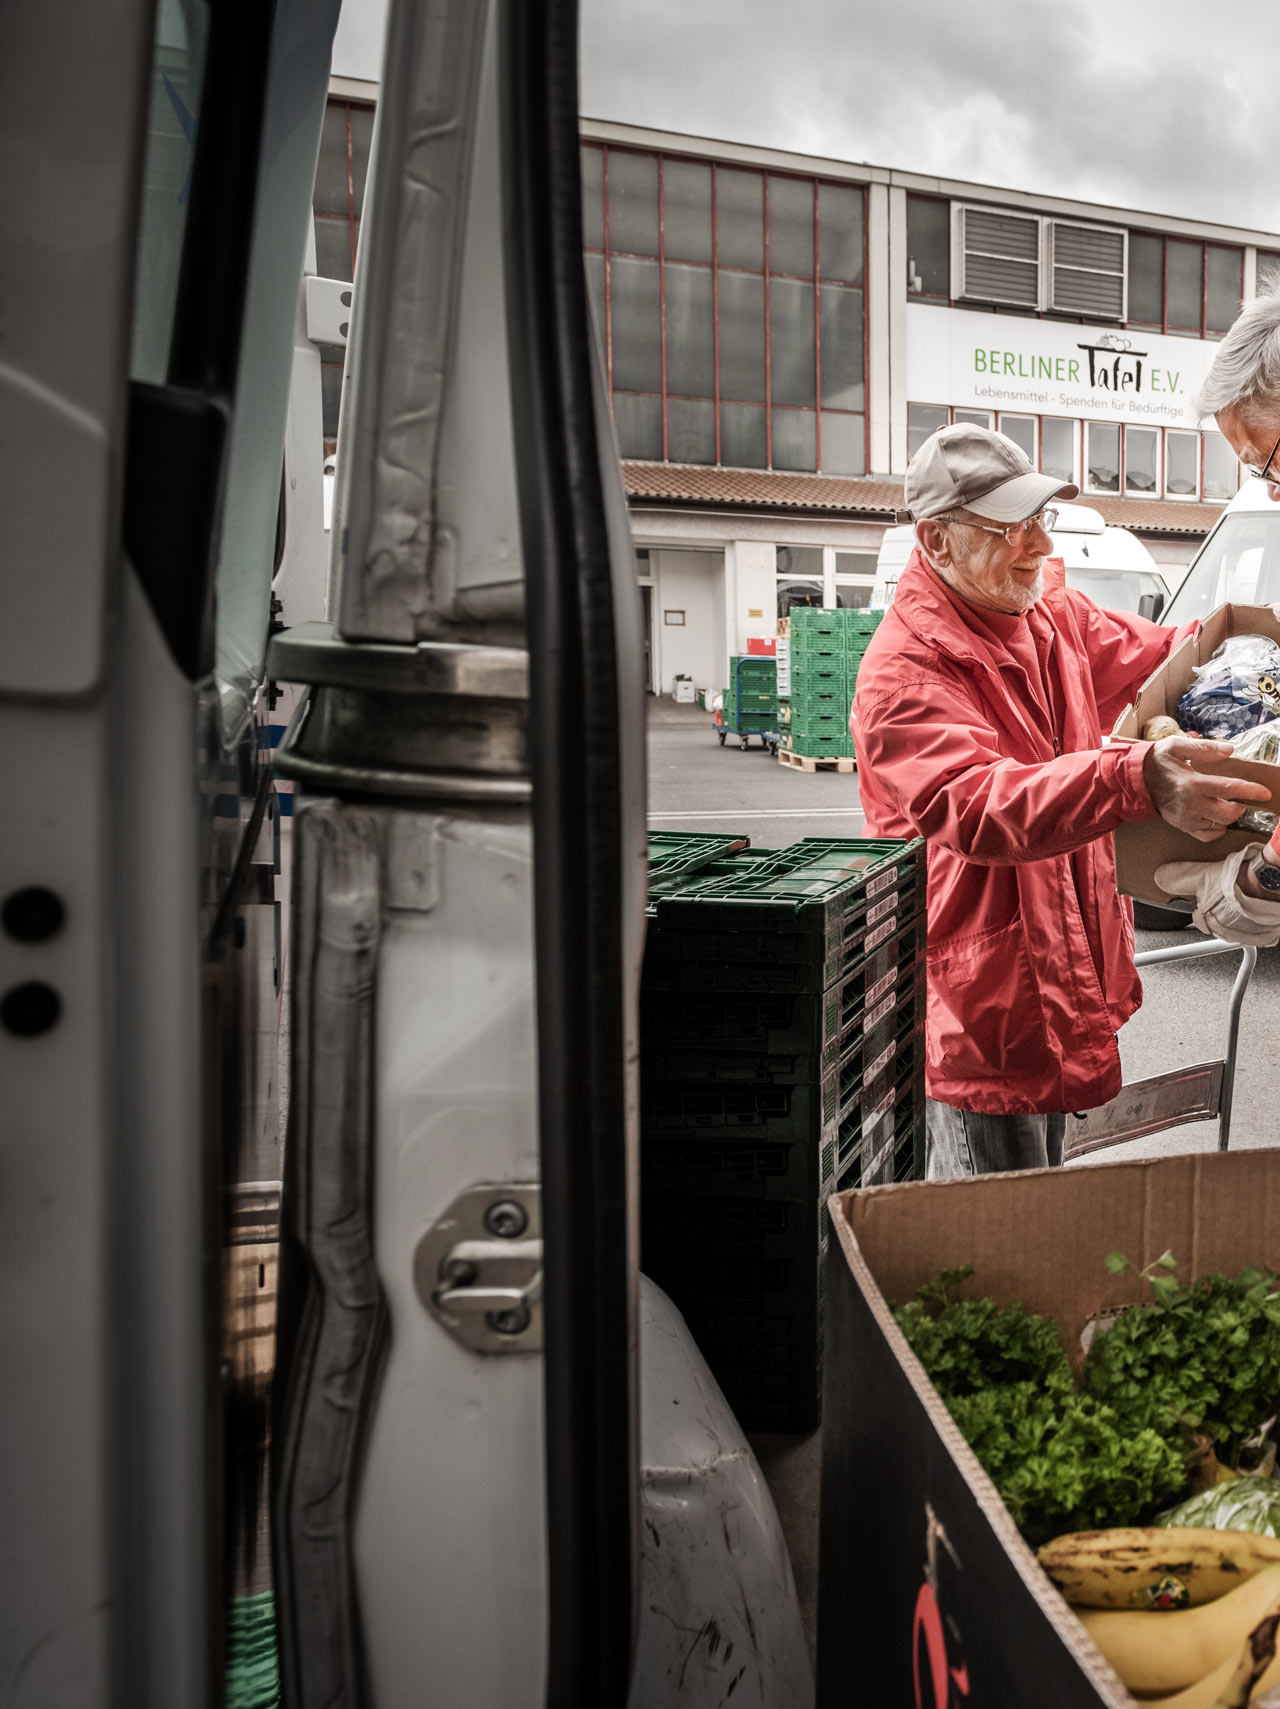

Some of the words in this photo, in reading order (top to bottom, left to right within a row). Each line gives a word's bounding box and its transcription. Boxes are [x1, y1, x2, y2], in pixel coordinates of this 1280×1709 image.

[974, 348, 1080, 383] BERLINER
[1077, 343, 1147, 392] Tafel
[1150, 369, 1184, 394] E.V.
[975, 385, 1048, 403] Lebensmittel
[1059, 393, 1108, 412] Spenden
[1110, 398, 1126, 411] für
[1128, 400, 1184, 417] Bedürftige
